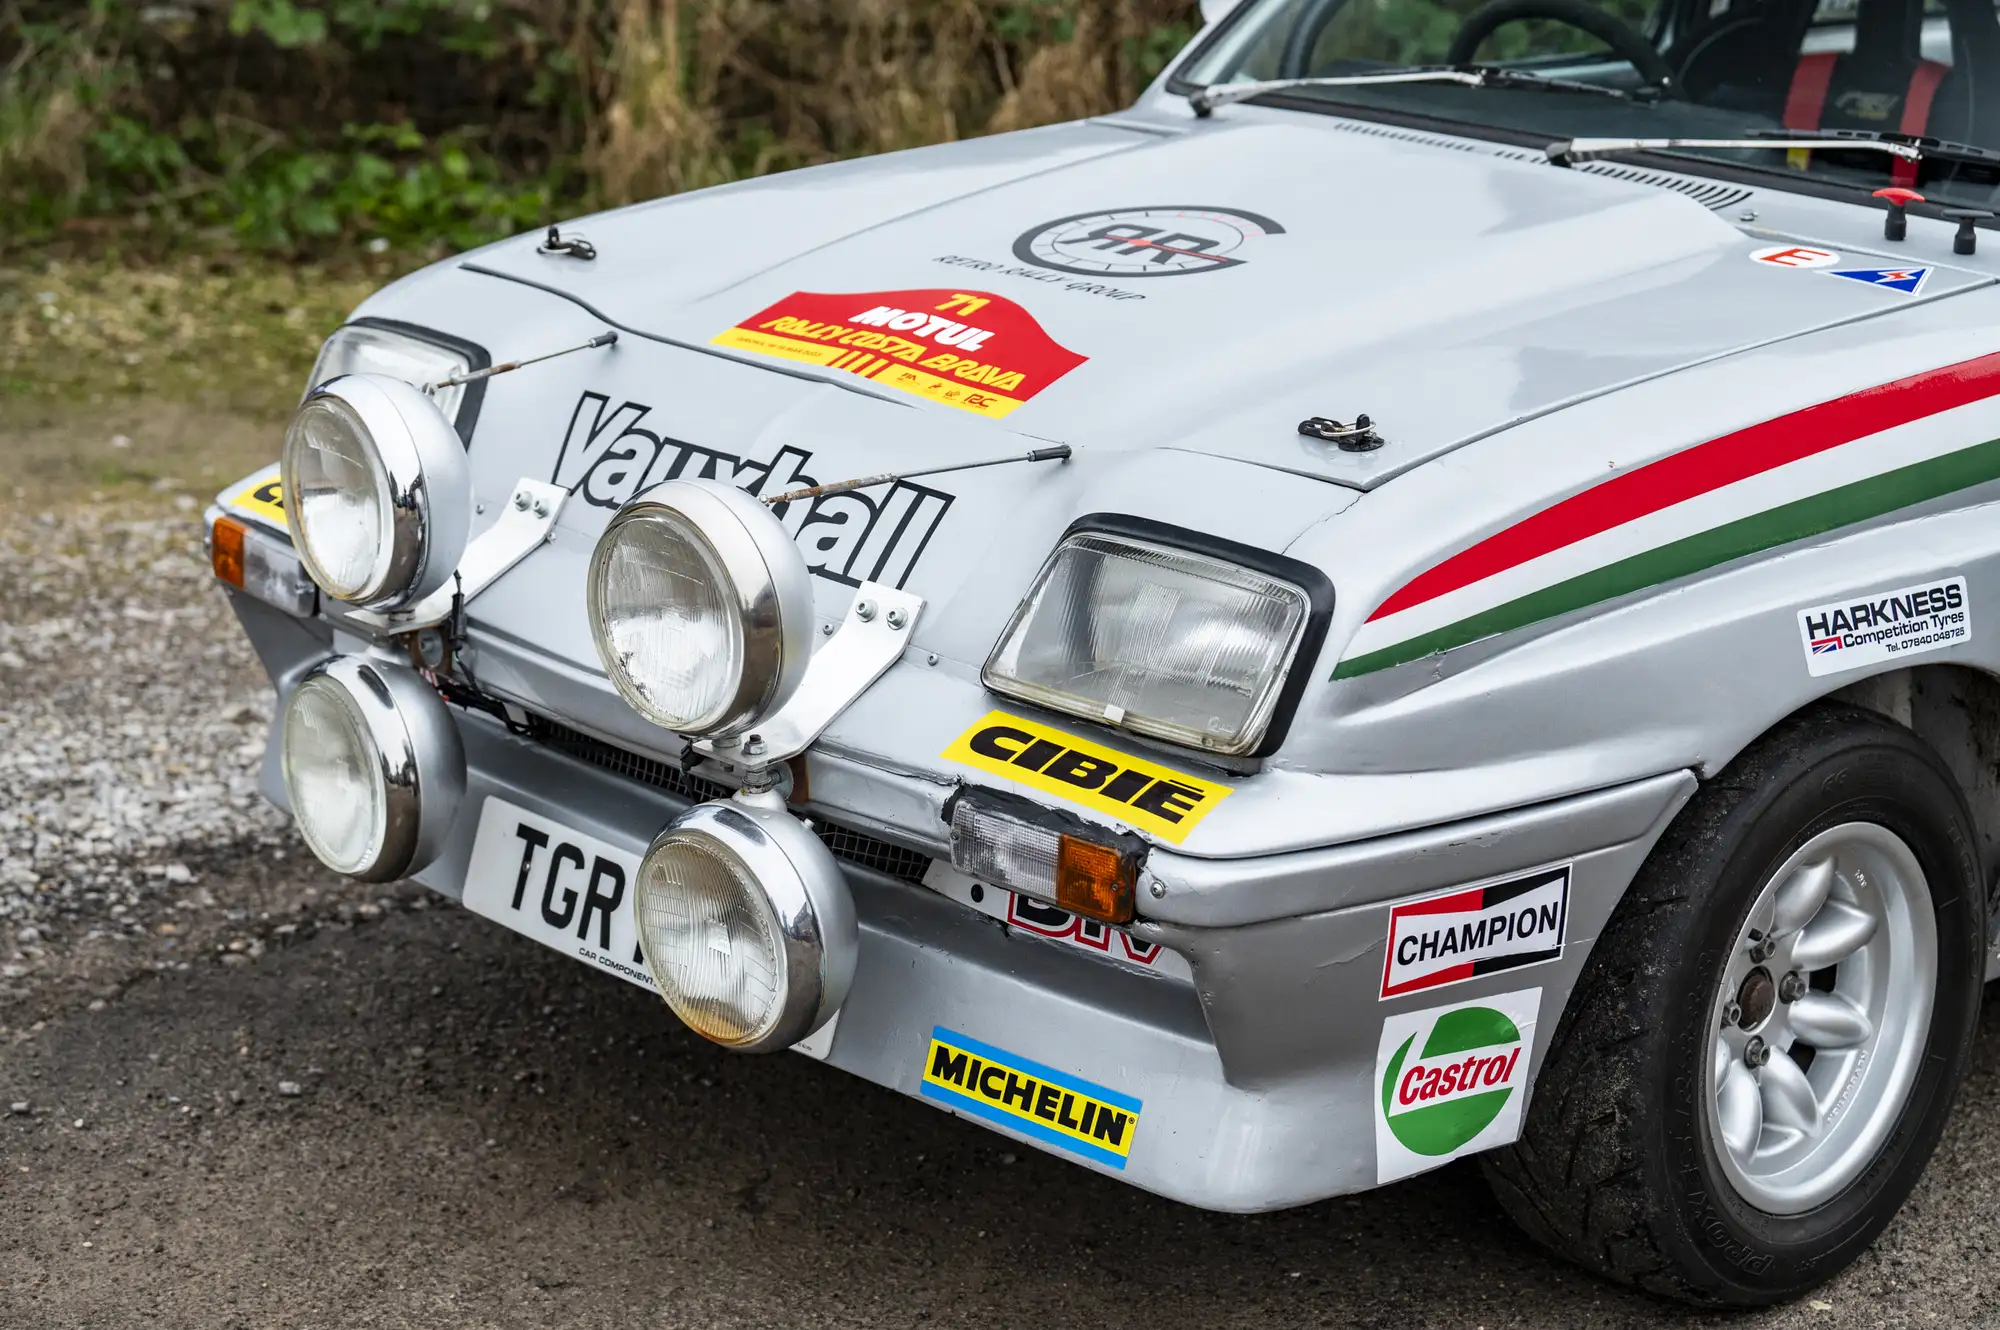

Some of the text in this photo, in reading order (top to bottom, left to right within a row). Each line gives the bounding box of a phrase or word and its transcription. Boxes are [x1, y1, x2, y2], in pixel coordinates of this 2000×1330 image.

[932, 254, 1147, 302] RETRO RALLY GROUP
[1760, 247, 1831, 266] E
[848, 305, 996, 352] MOTUL
[934, 293, 990, 317] 71
[759, 315, 1027, 393] RALLY COSTA BRAVA
[1805, 584, 1963, 640] HARKNESS
[1843, 611, 1965, 648] Competition Tyres
[1885, 643, 1900, 653] Tel.
[1901, 635, 1933, 650] 07840
[512, 822, 626, 951] TGR
[1397, 901, 1559, 966] CHAMPION
[578, 947, 657, 987] CAR COMPONENT
[931, 1045, 1128, 1147] MICHELIN
[1398, 1047, 1522, 1106] Castrol
